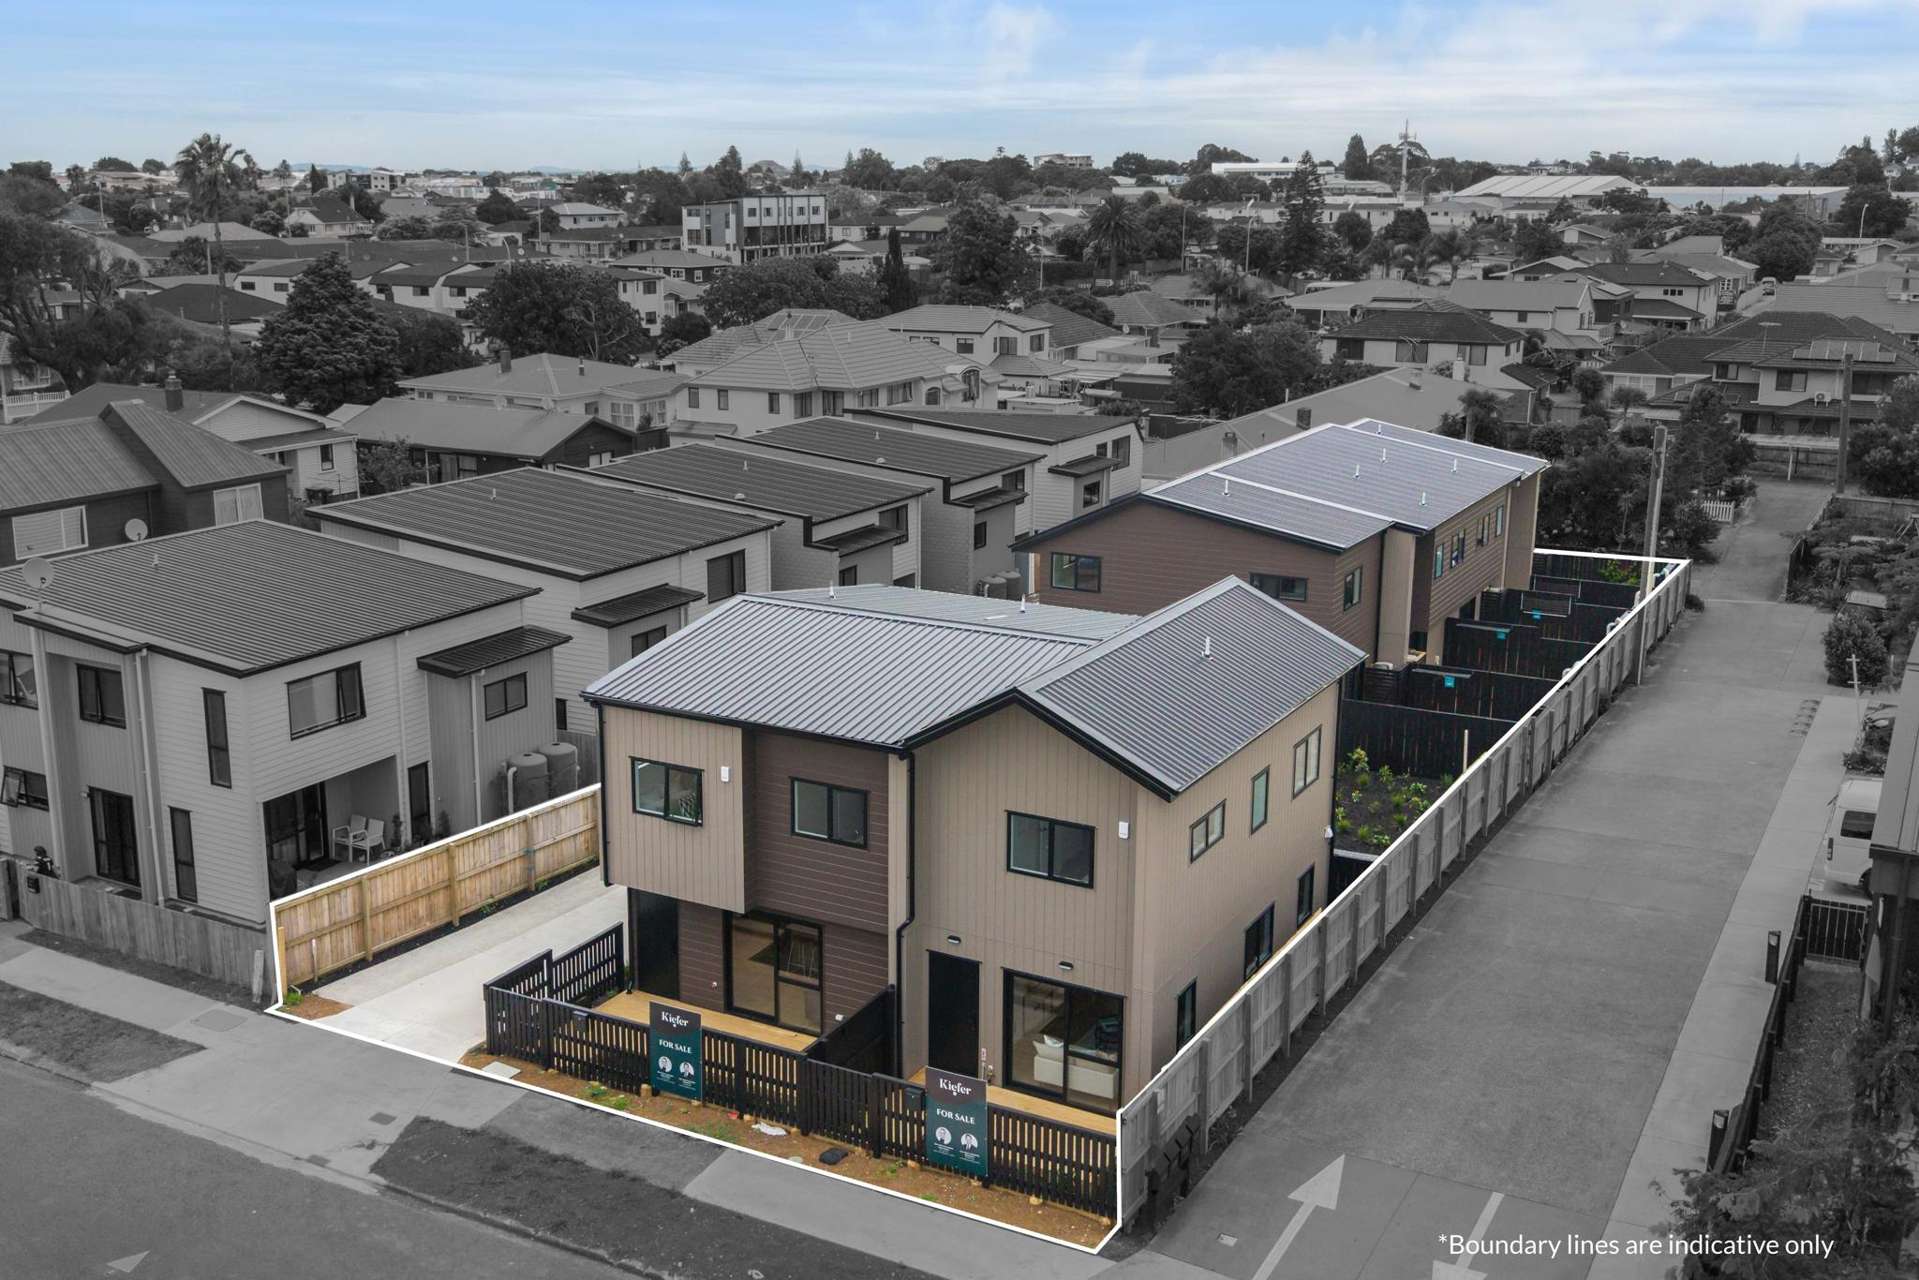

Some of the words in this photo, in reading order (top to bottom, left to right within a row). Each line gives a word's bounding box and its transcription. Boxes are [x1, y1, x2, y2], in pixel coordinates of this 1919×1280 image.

[661, 1011, 689, 1028] Kiefer
[659, 1039, 674, 1049] FOR
[674, 1043, 692, 1054] SALE
[939, 1078, 972, 1096] Kiefer
[936, 1108, 953, 1120] FOR
[955, 1113, 976, 1125] SALE
